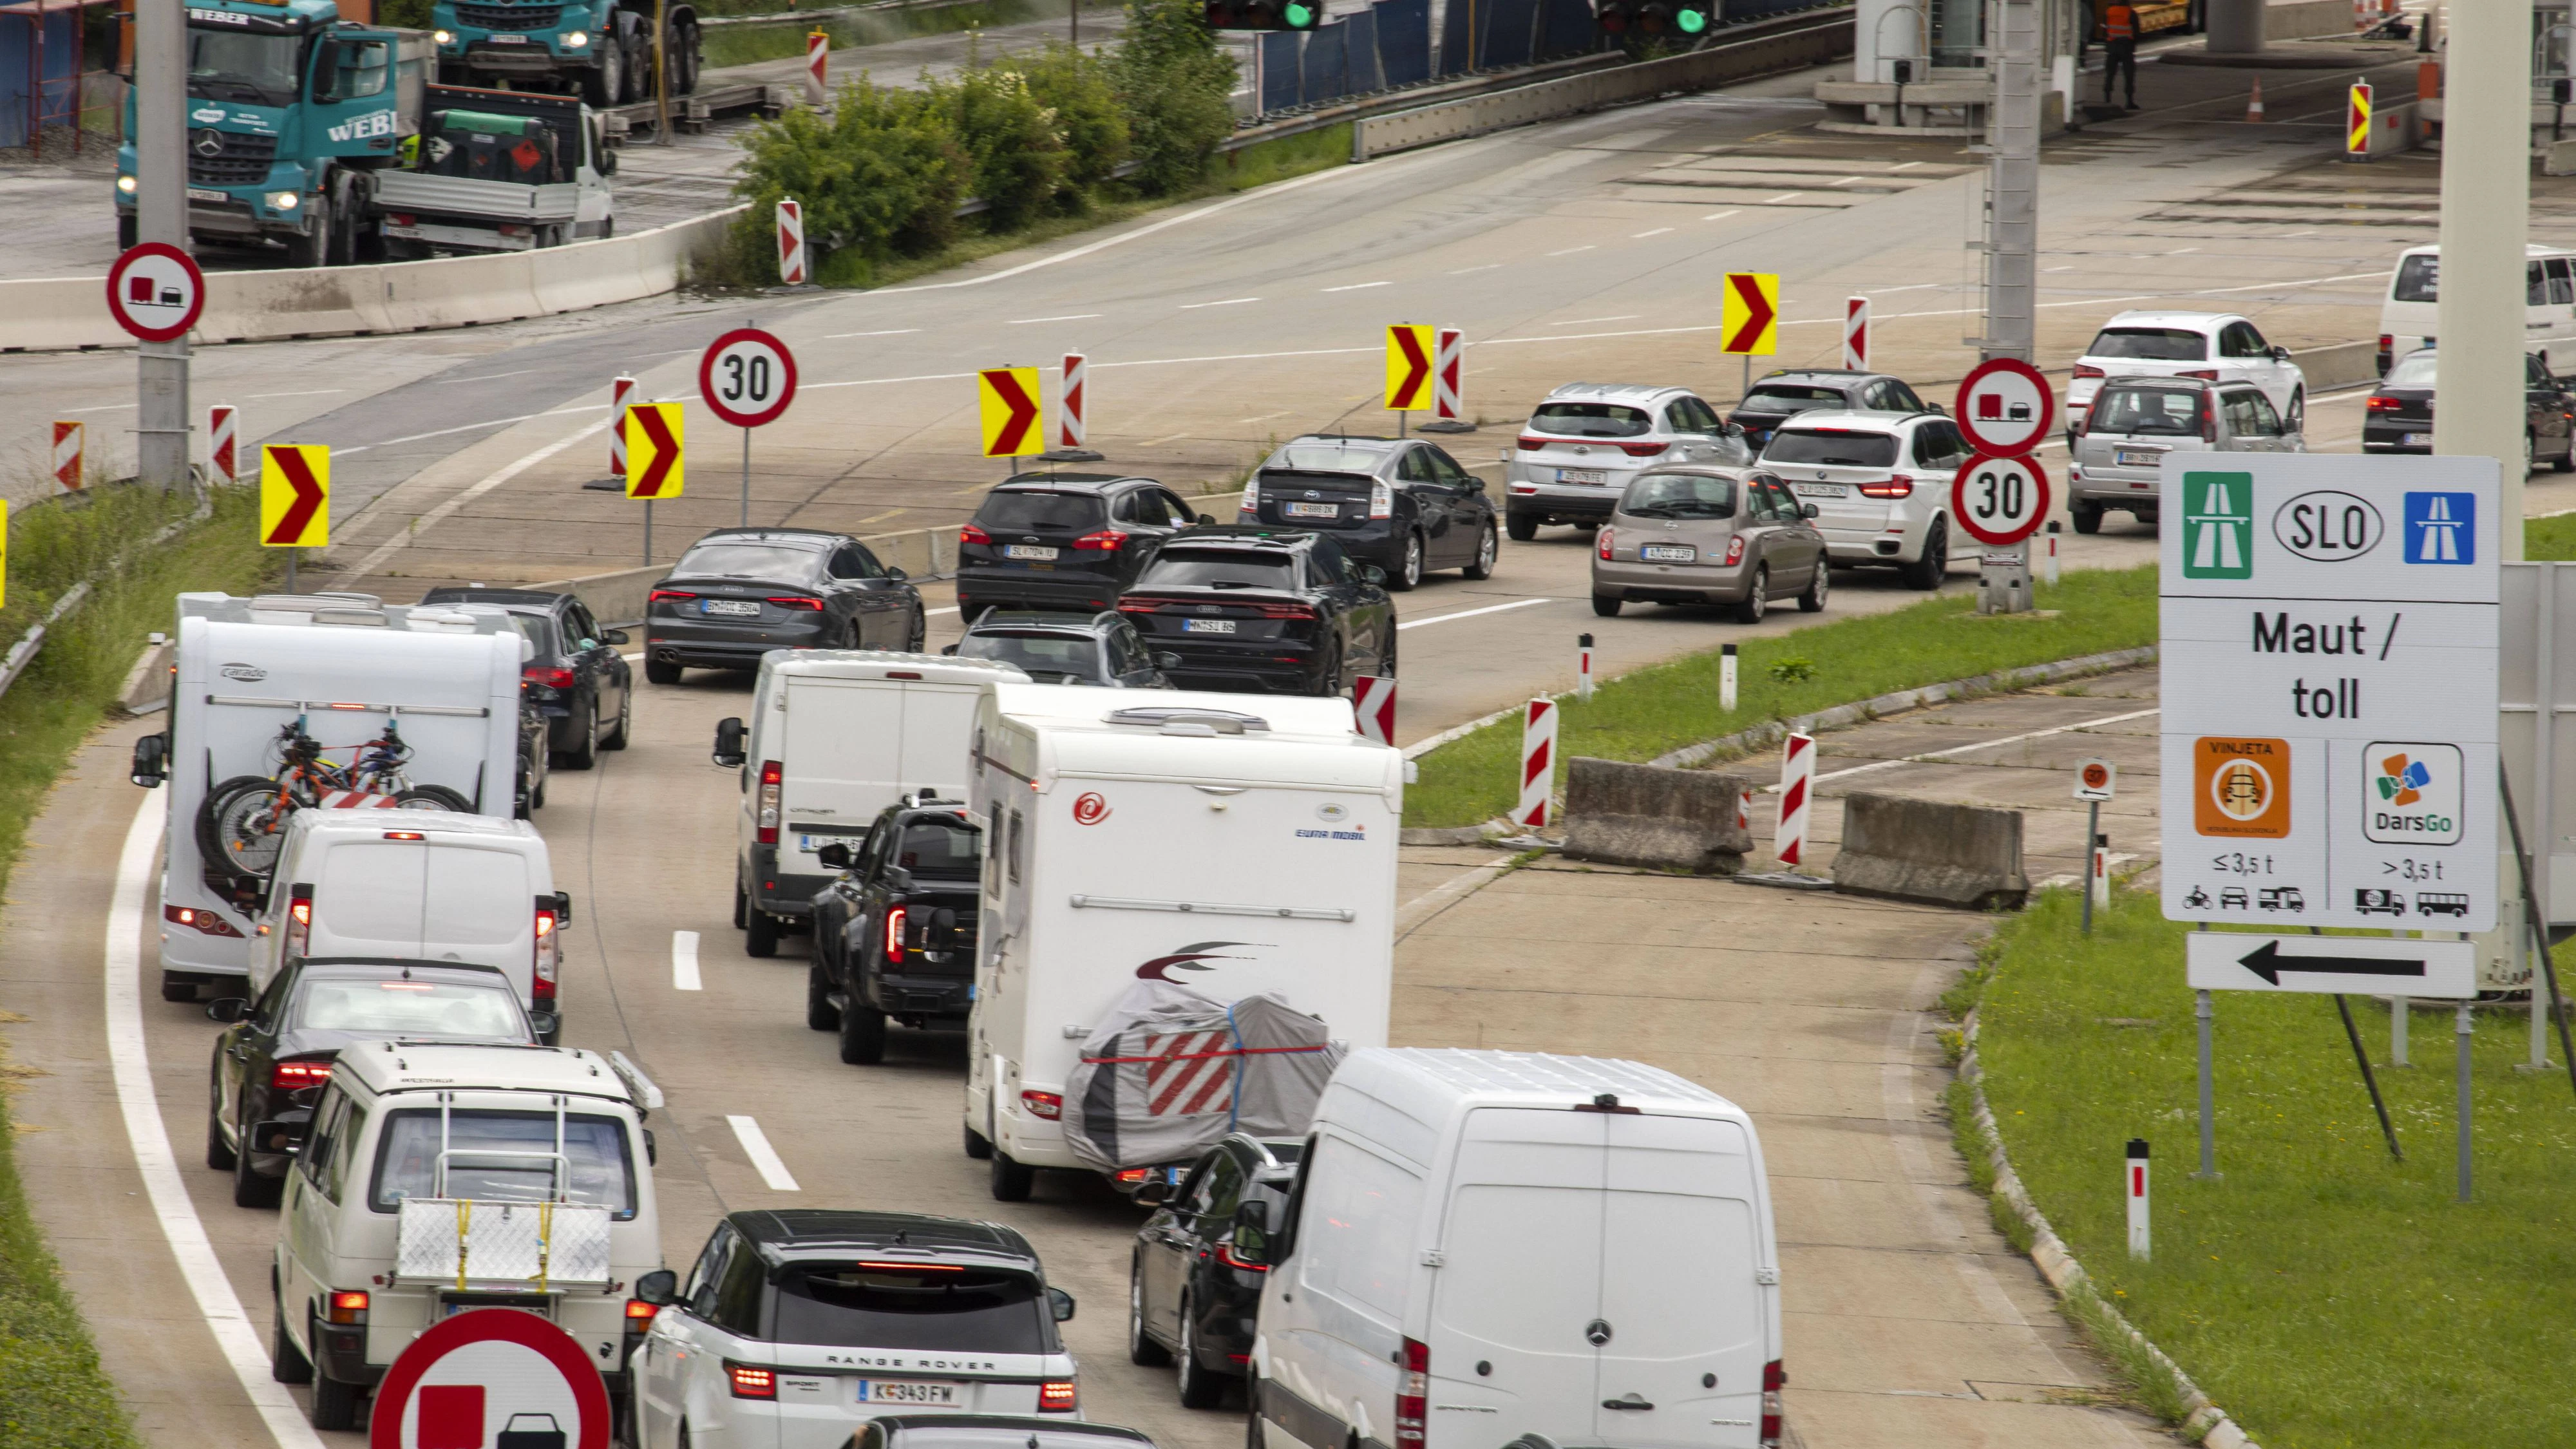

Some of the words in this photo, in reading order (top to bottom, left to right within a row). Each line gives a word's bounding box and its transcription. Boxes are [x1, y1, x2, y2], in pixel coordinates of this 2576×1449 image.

[191, 8, 250, 25] WEBER
[723, 354, 769, 402] 30
[1976, 471, 2023, 520] 30
[2291, 504, 2366, 550] SLO
[2253, 612, 2367, 655] Maut
[2378, 612, 2402, 661] /
[2291, 677, 2360, 719] toll
[2209, 742, 2273, 755] VINJETA
[2376, 812, 2452, 833] DarsGo
[2265, 854, 2274, 874] t
[2436, 860, 2444, 880] t
[827, 1355, 903, 1367] RANGE
[918, 1359, 996, 1370] ROVER
[874, 1383, 885, 1399] K
